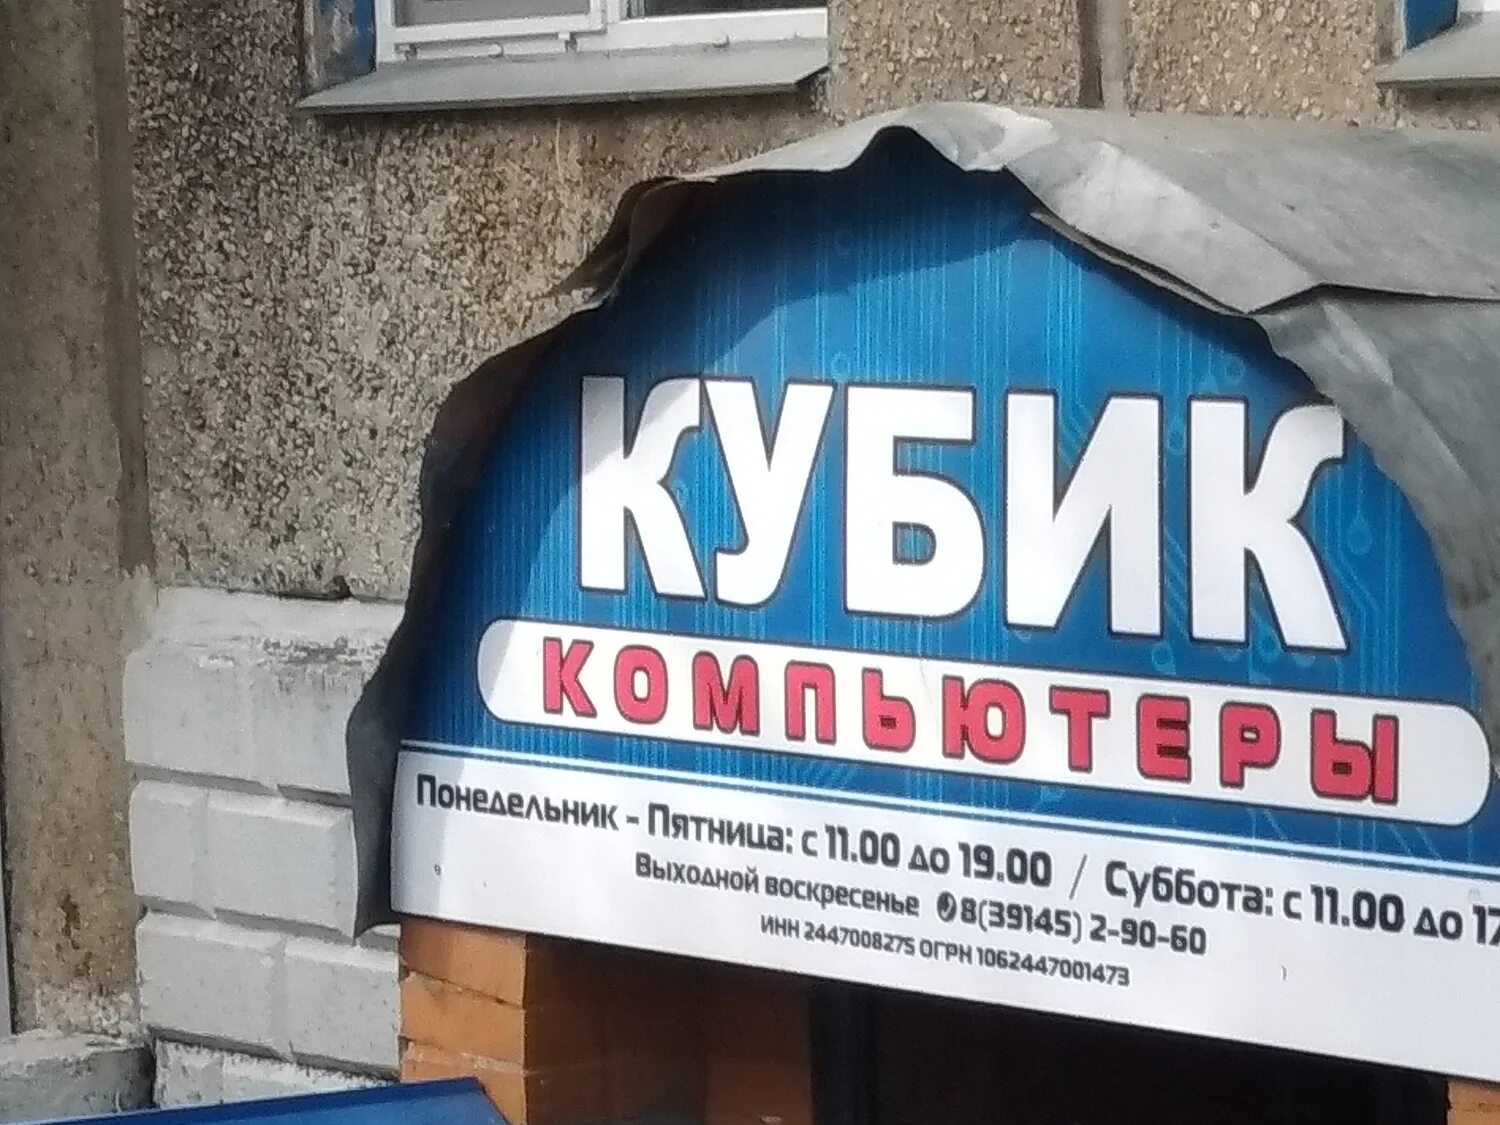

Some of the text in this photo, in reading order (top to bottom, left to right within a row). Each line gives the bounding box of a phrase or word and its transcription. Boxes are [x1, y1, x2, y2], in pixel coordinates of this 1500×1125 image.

[577, 374, 1347, 652] КУБИК
[542, 638, 1400, 804] КОМПЬЮТЕРЫ
[416, 774, 620, 832] Понедельник
[647, 803, 793, 854] Пятница:
[824, 824, 901, 868] 11.00
[908, 843, 950, 875] до
[957, 842, 1052, 888] 19.00
[1104, 860, 1274, 918] Суббота:
[1309, 883, 1402, 933] 11.00
[1413, 910, 1463, 942] до
[634, 852, 1207, 956] Выходной воскресенье 8(39145) 2-90-60
[759, 914, 801, 938] ИНН
[919, 938, 973, 966] ОГРН
[976, 946, 1131, 988] 1062447001473
